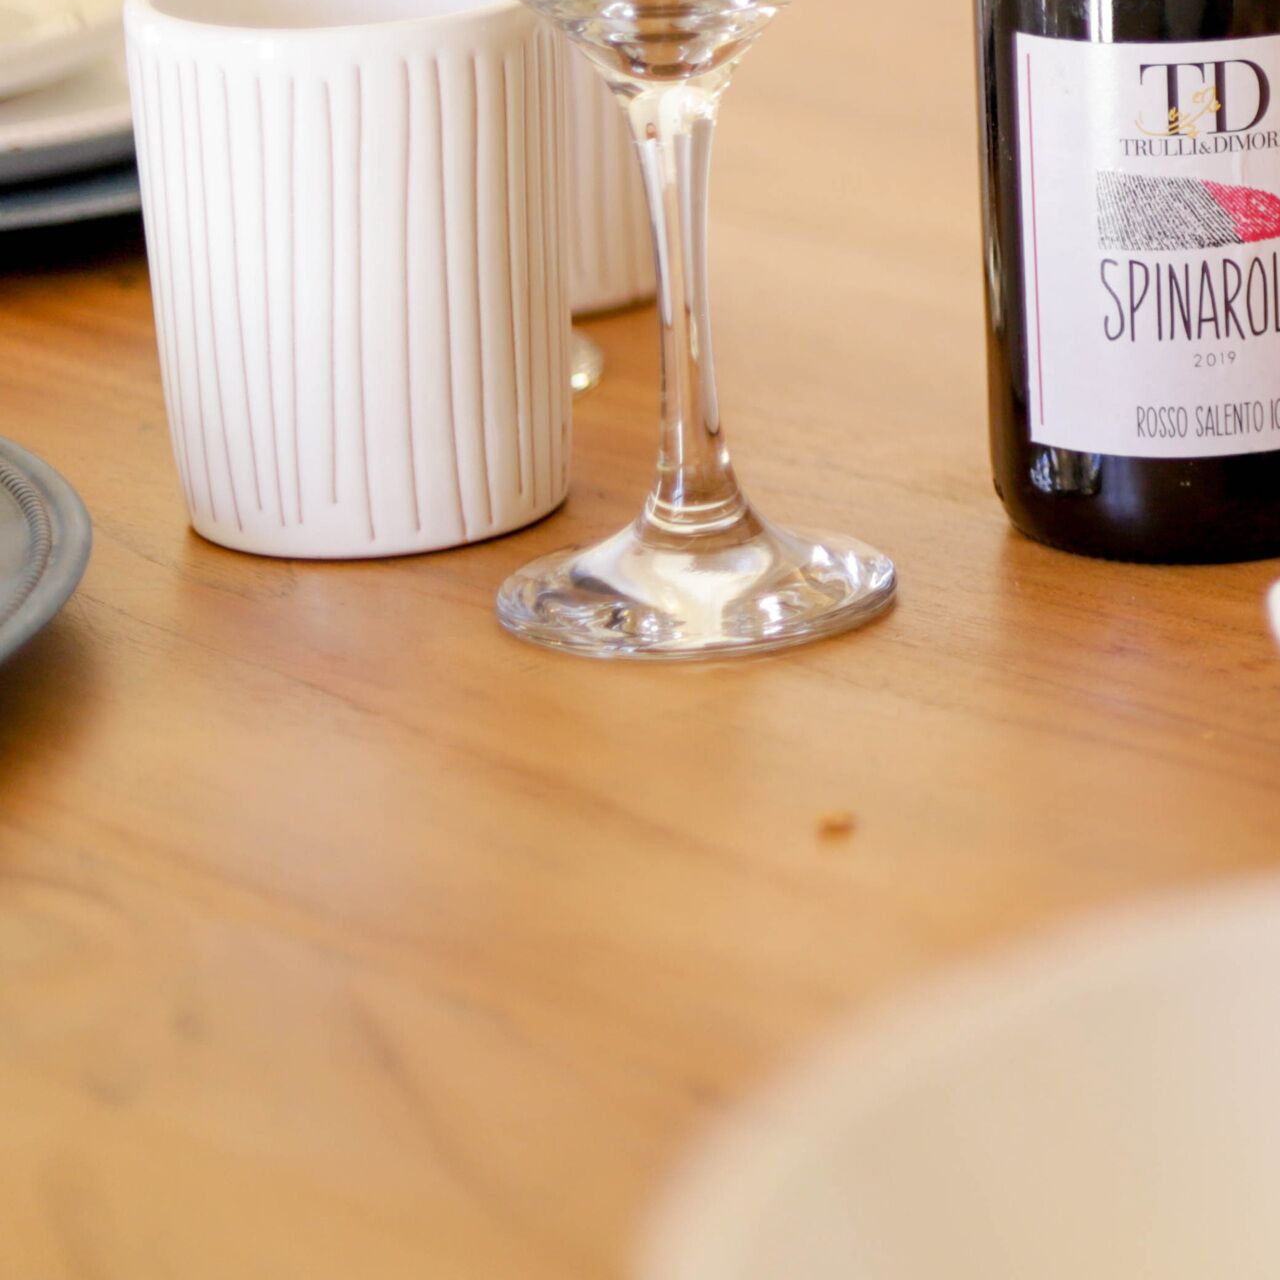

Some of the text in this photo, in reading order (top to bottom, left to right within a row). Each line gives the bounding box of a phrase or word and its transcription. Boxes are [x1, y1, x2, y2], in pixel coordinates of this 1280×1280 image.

[1139, 58, 1271, 136] TD
[1193, 351, 1237, 368] 2019
[1136, 405, 1188, 438] ROSSO
[1195, 400, 1264, 438] SALENTO
